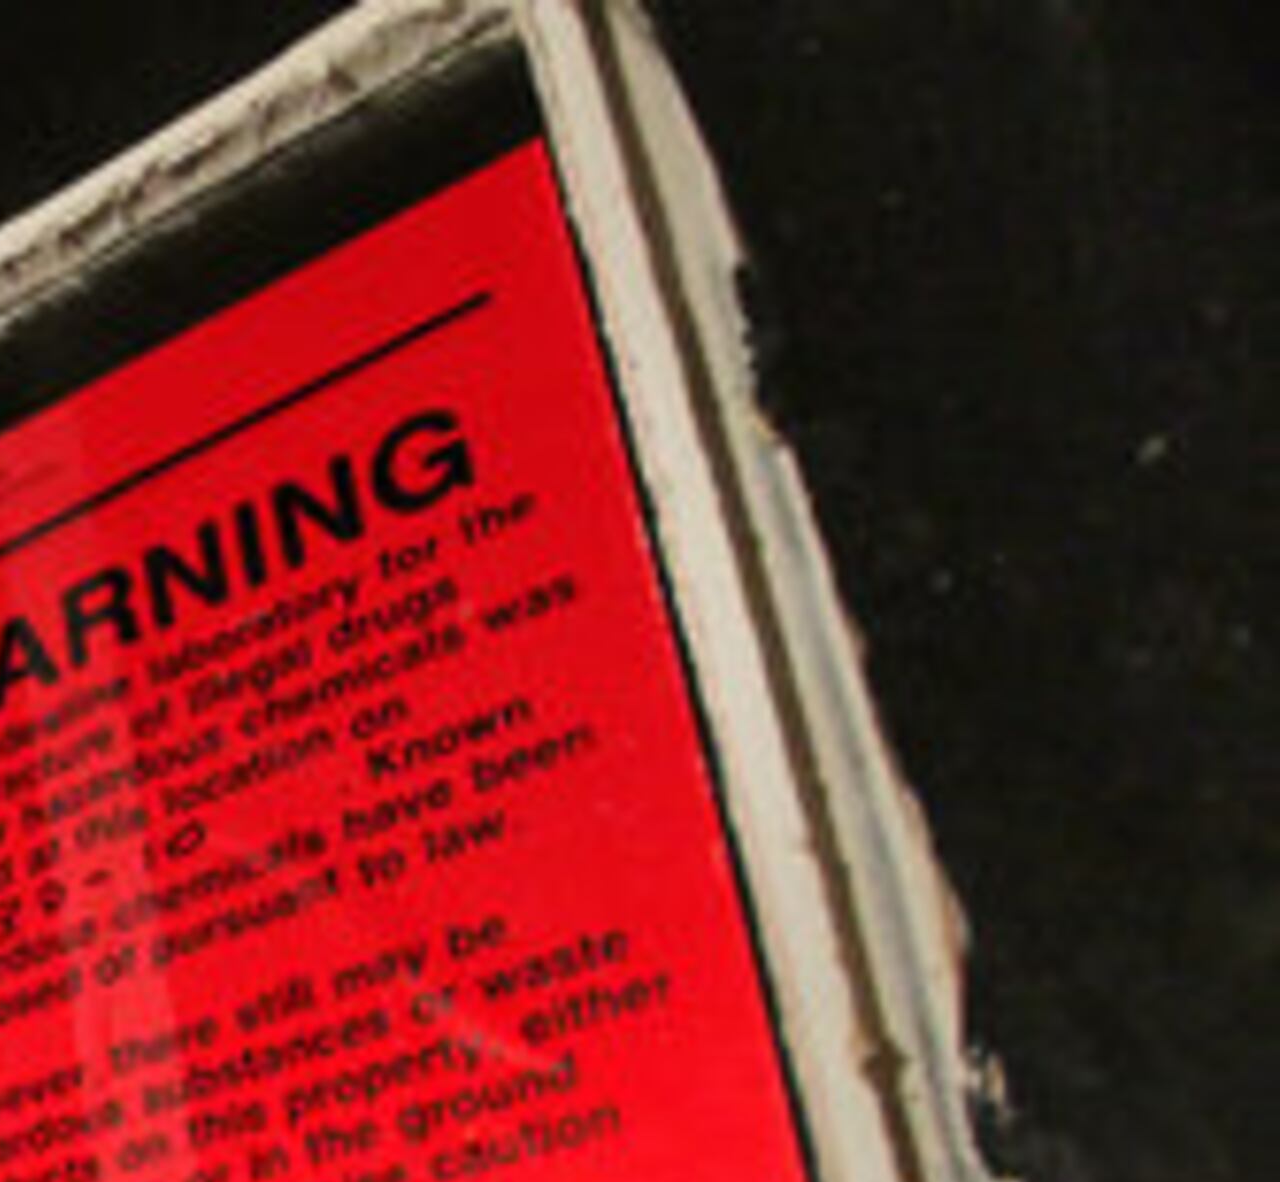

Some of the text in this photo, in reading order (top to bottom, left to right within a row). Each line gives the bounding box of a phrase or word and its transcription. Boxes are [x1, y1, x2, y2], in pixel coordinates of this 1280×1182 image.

[128, 697, 171, 742] of
[187, 633, 313, 722] illegal
[327, 568, 460, 661] drugs
[146, 568, 359, 695] laboratory
[377, 529, 438, 583] for
[458, 483, 537, 546] the
[237, 617, 466, 742] chemicals
[484, 572, 577, 636] was
[27, 836, 61, 876] at
[74, 795, 148, 855] this
[161, 719, 335, 819] location
[347, 693, 408, 742] on
[366, 688, 531, 783] Known
[112, 823, 327, 933] chemicals
[339, 772, 454, 846] have
[468, 714, 598, 794] been
[93, 945, 138, 991] of
[150, 871, 340, 973] pursuant
[356, 845, 406, 890] to
[108, 1010, 221, 1078] there
[233, 974, 316, 1035] still
[331, 937, 432, 1009] may
[445, 907, 510, 962] be
[114, 1128, 173, 1176] on
[186, 1093, 267, 1152] this
[513, 963, 673, 1049] either
[140, 1002, 392, 1117] substances
[409, 983, 461, 1028] or
[475, 923, 631, 1006] waste
[302, 1110, 381, 1169] the
[392, 1048, 584, 1150] ground
